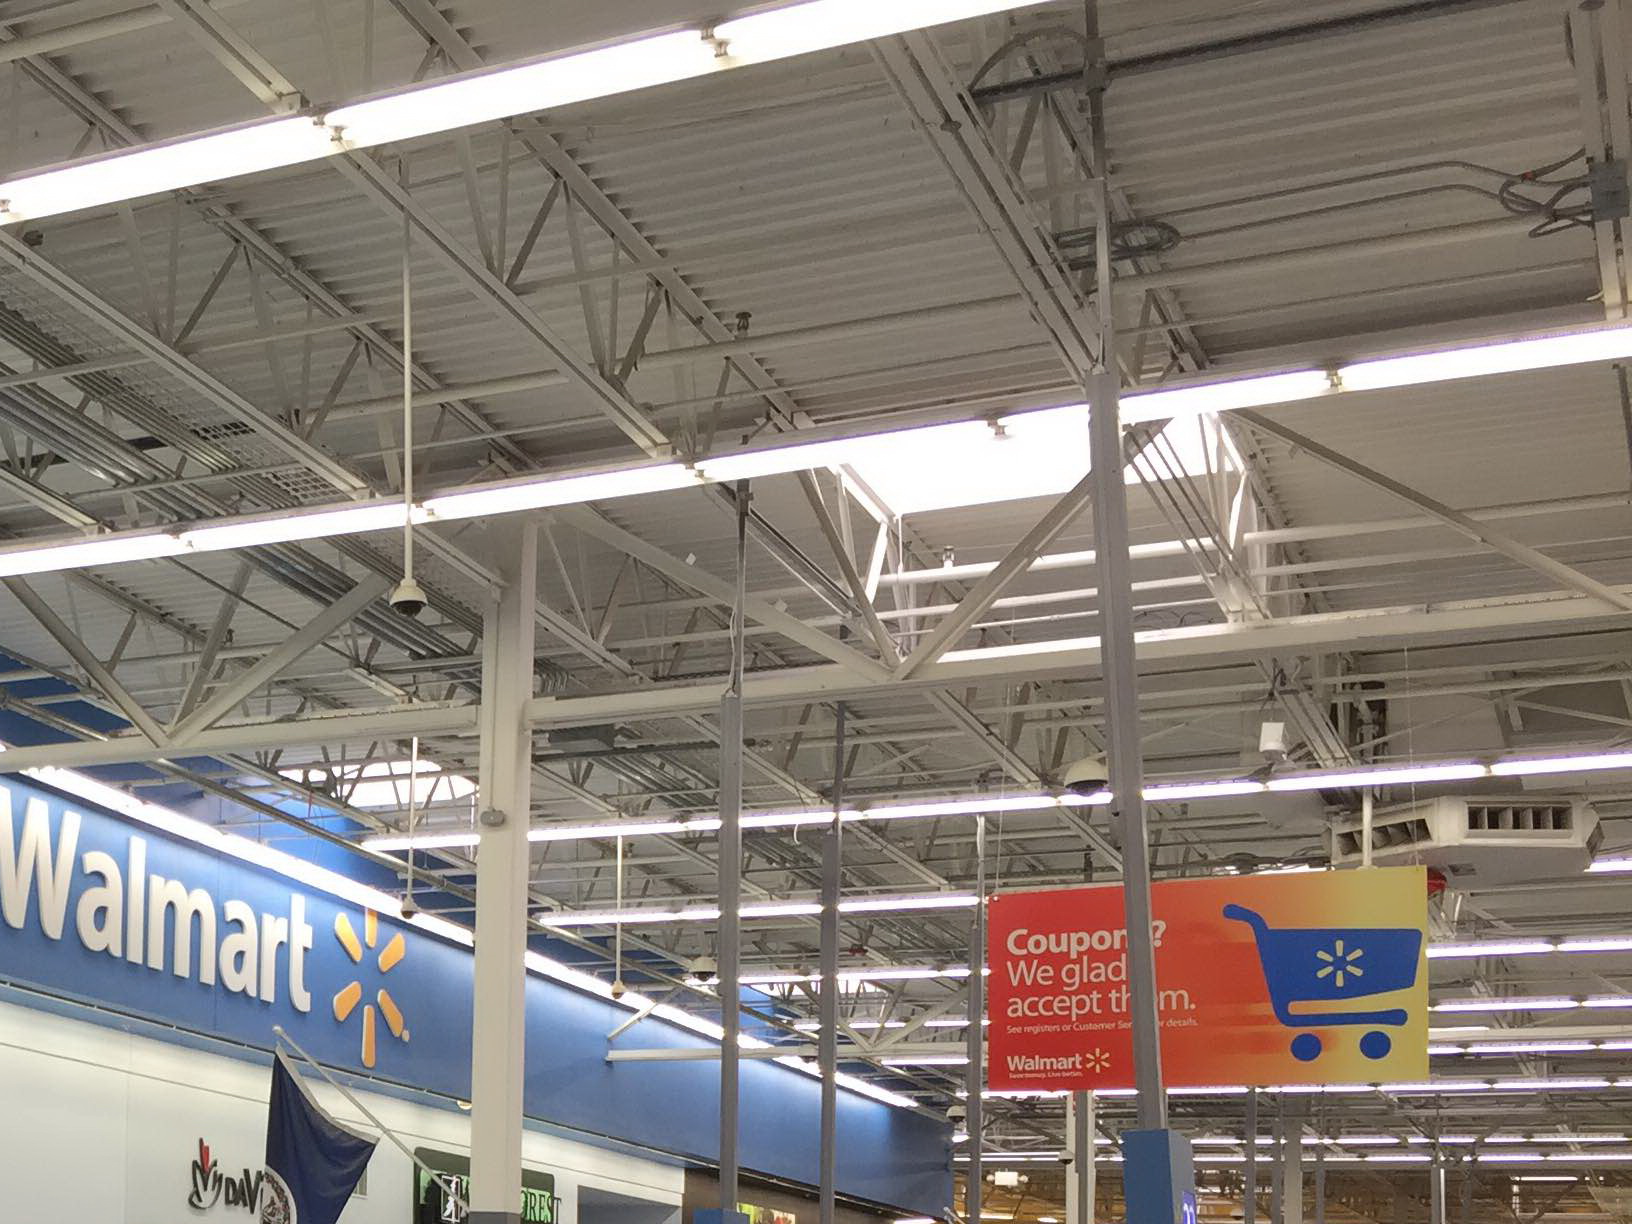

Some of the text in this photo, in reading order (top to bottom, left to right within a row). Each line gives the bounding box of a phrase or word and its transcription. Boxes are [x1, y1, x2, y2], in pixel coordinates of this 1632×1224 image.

[1006, 920, 1167, 959] Coupon?
[1006, 953, 1128, 992] We glad
[1007, 984, 1197, 1021] accept thm.
[1073, 1021, 1116, 1033] Customer
[1006, 1053, 1082, 1072] Walmart
